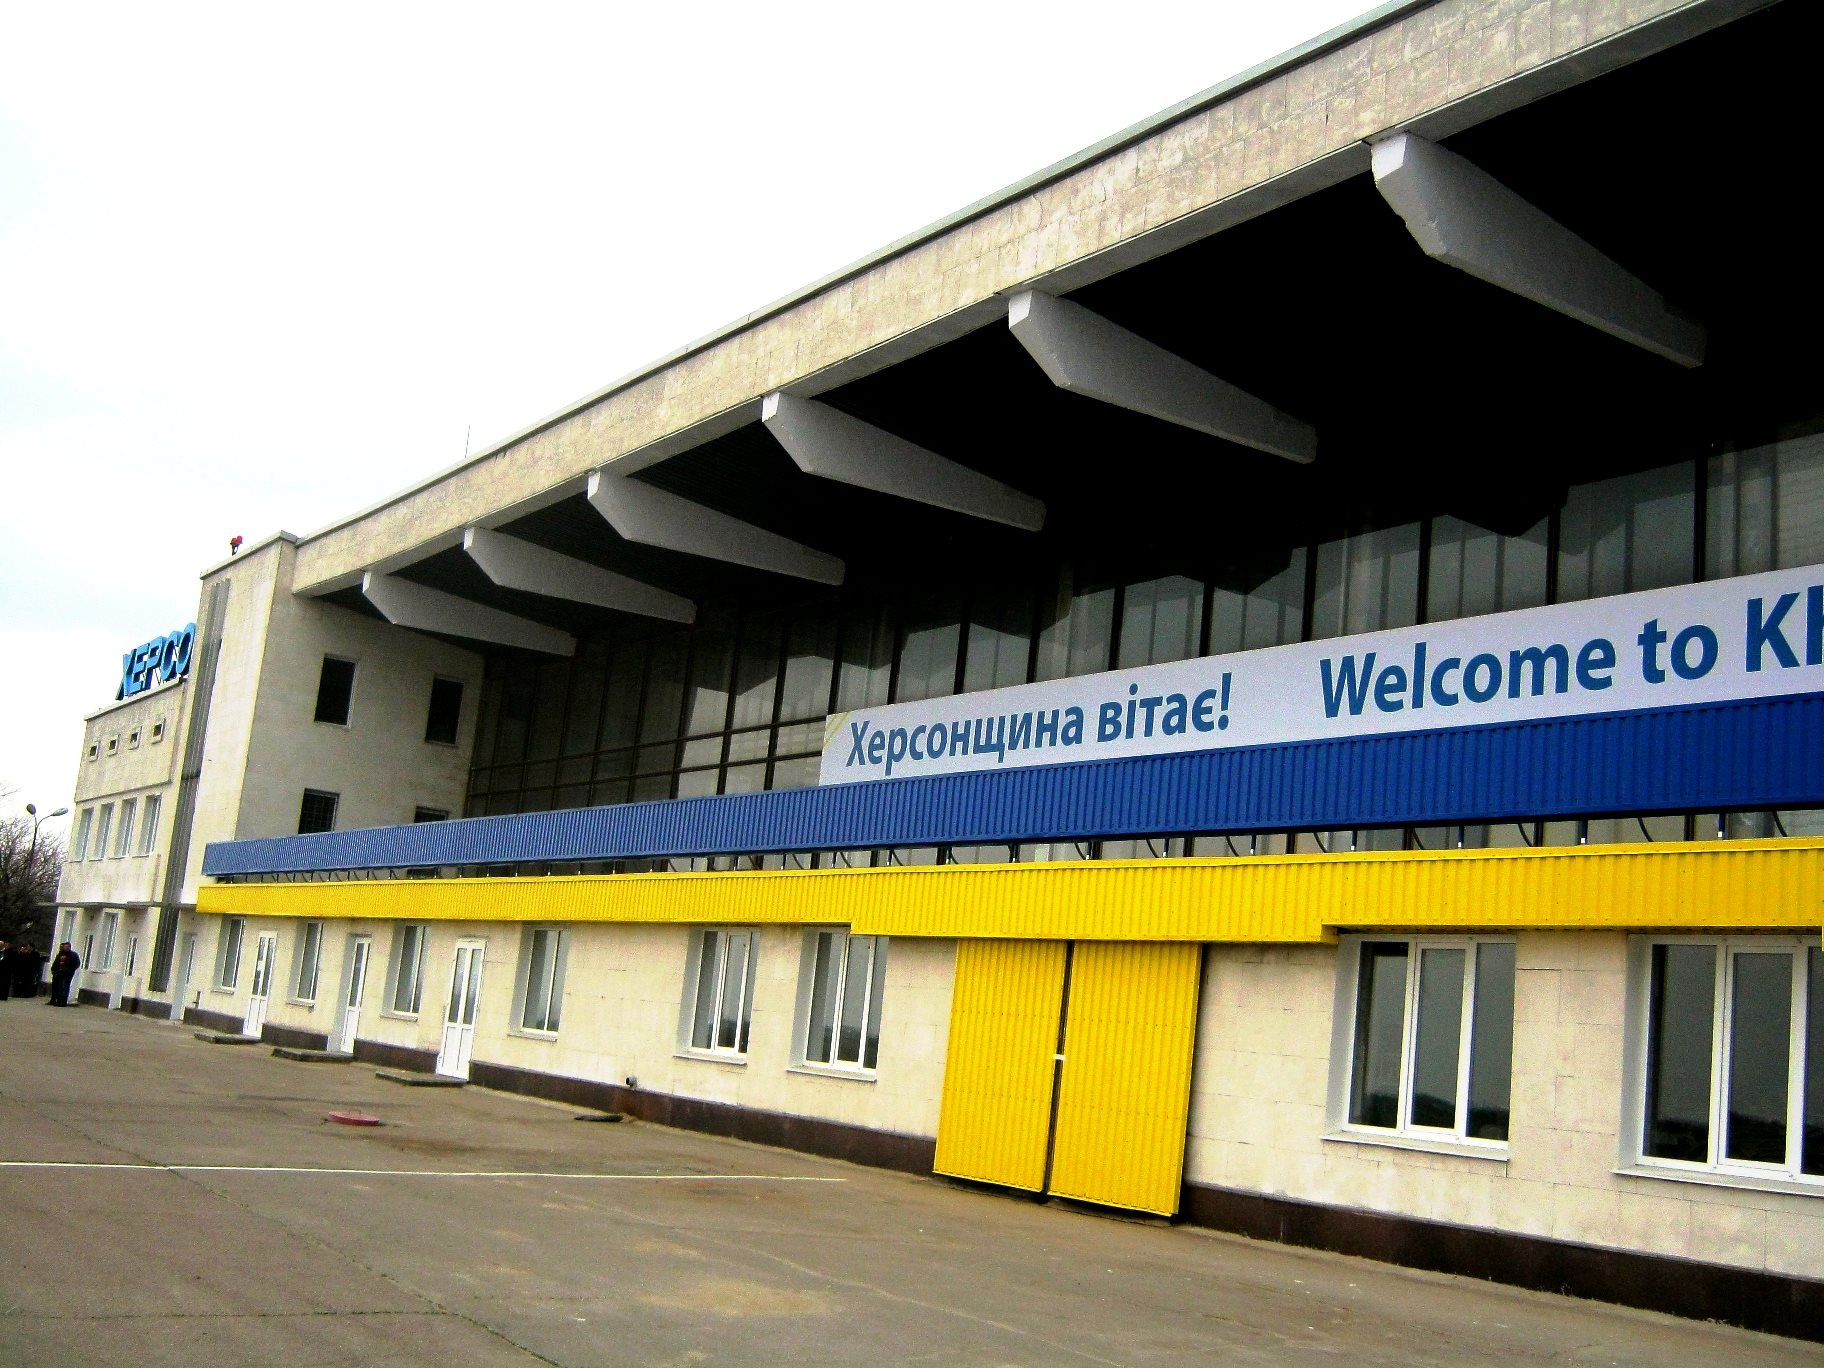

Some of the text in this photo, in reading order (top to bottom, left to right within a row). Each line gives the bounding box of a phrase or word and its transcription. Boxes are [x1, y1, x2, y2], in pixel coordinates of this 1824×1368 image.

[1319, 637, 1616, 719] Welcome
[1637, 617, 1719, 685] to
[845, 672, 1233, 776] Херсонщина вітає!
